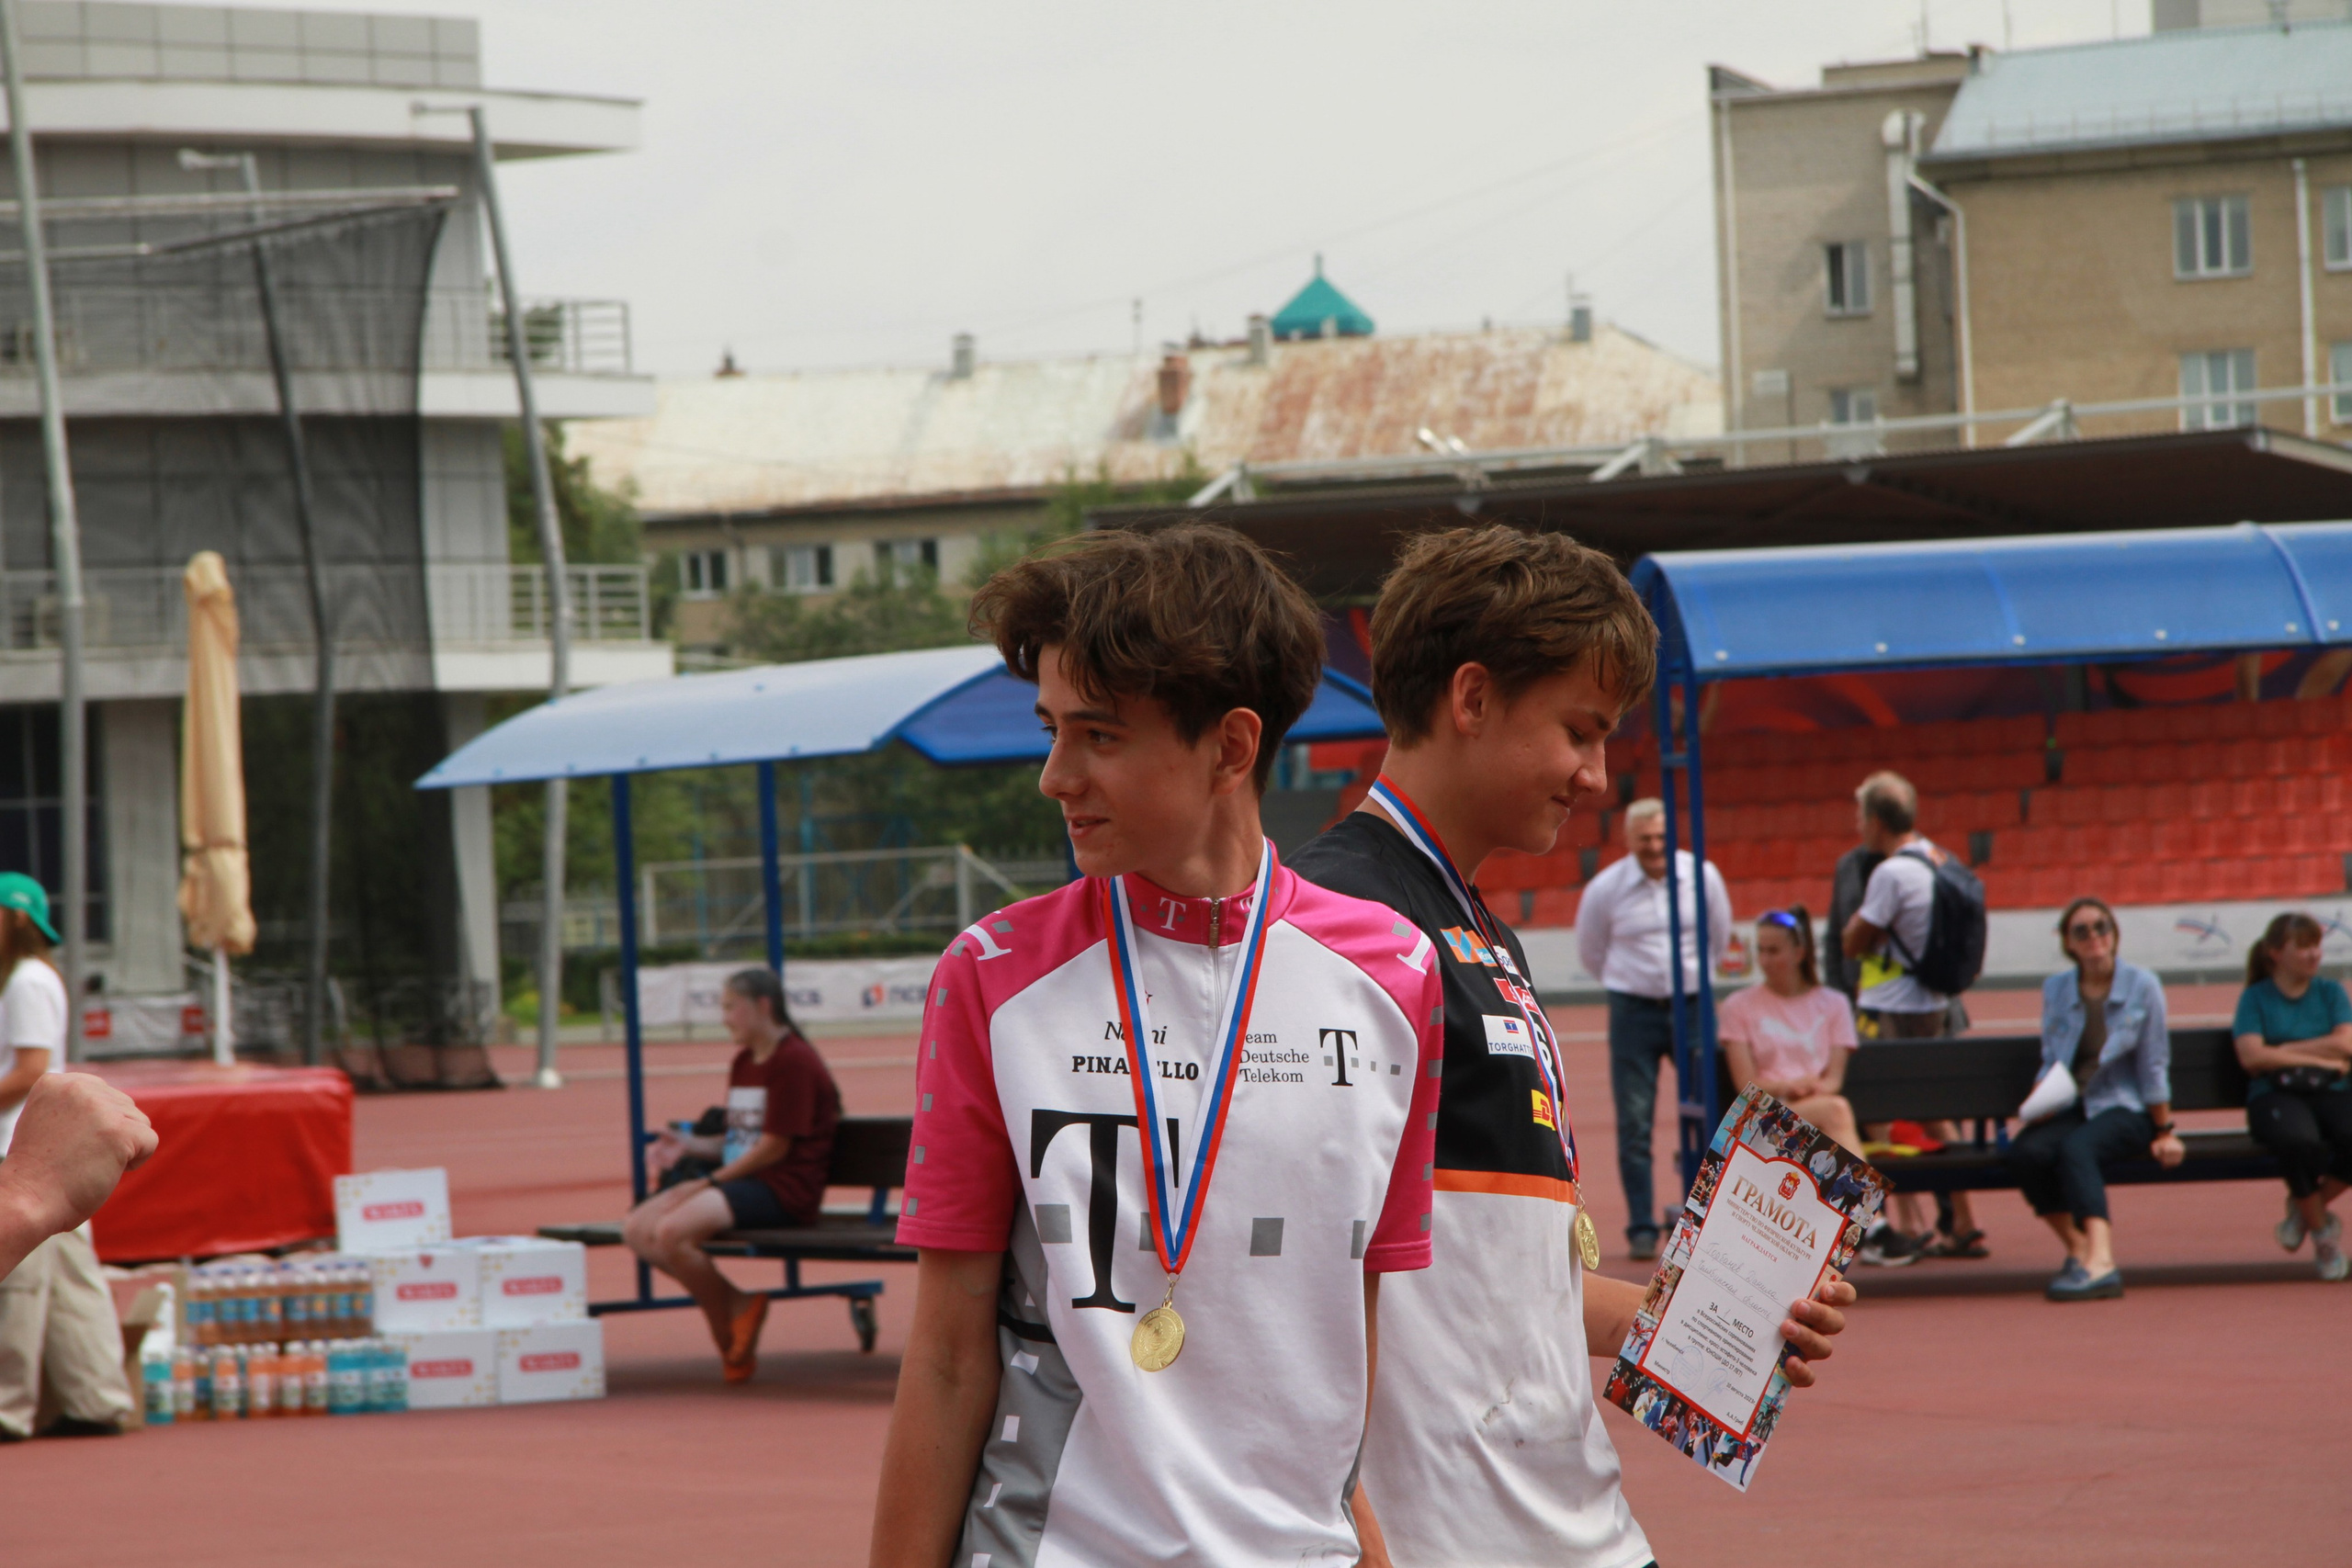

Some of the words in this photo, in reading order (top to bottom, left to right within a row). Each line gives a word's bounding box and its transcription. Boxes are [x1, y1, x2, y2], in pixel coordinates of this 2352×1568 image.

[1159, 897, 1186, 931] T
[1104, 1021, 1168, 1044] Nni
[1244, 1032, 1278, 1044] eam
[1071, 1055, 1199, 1080] PINALLO
[1240, 1048, 1310, 1064] Deutsche
[1319, 1028, 1358, 1087] T
[1240, 1068, 1304, 1083] Telekom
[1030, 1108, 1180, 1314] T
[1731, 1175, 1817, 1250] ГРАМОТА
[1726, 1198, 1758, 1224] МИНИСТЕРСТВО
[1757, 1220, 1764, 1228] ПО
[1764, 1224, 1791, 1247] ФИЗИЧЕСКОЙ
[1790, 1243, 1812, 1260] КУЛЬТУРЕ
[1736, 1213, 1751, 1227] СПОРТУ
[1751, 1224, 1781, 1247] ЧЕЛЯБИНСКОЙ
[1780, 1245, 1799, 1261] ОБЛАСТИ
[1741, 1235, 1778, 1263] НАГРАЖДАЕТСЯ
[1700, 1310, 1728, 1333] Всероссийских
[1728, 1331, 1756, 1353] соревнованиях
[1709, 1302, 1718, 1314] ЗА
[1732, 1318, 1754, 1338] МЕСТО
[1697, 1320, 1723, 1341] спортивному
[1722, 1337, 1754, 1362] ориентированию
[1705, 1347, 1722, 1361] ЮНОШИ
[1654, 1360, 1670, 1375] Министр
